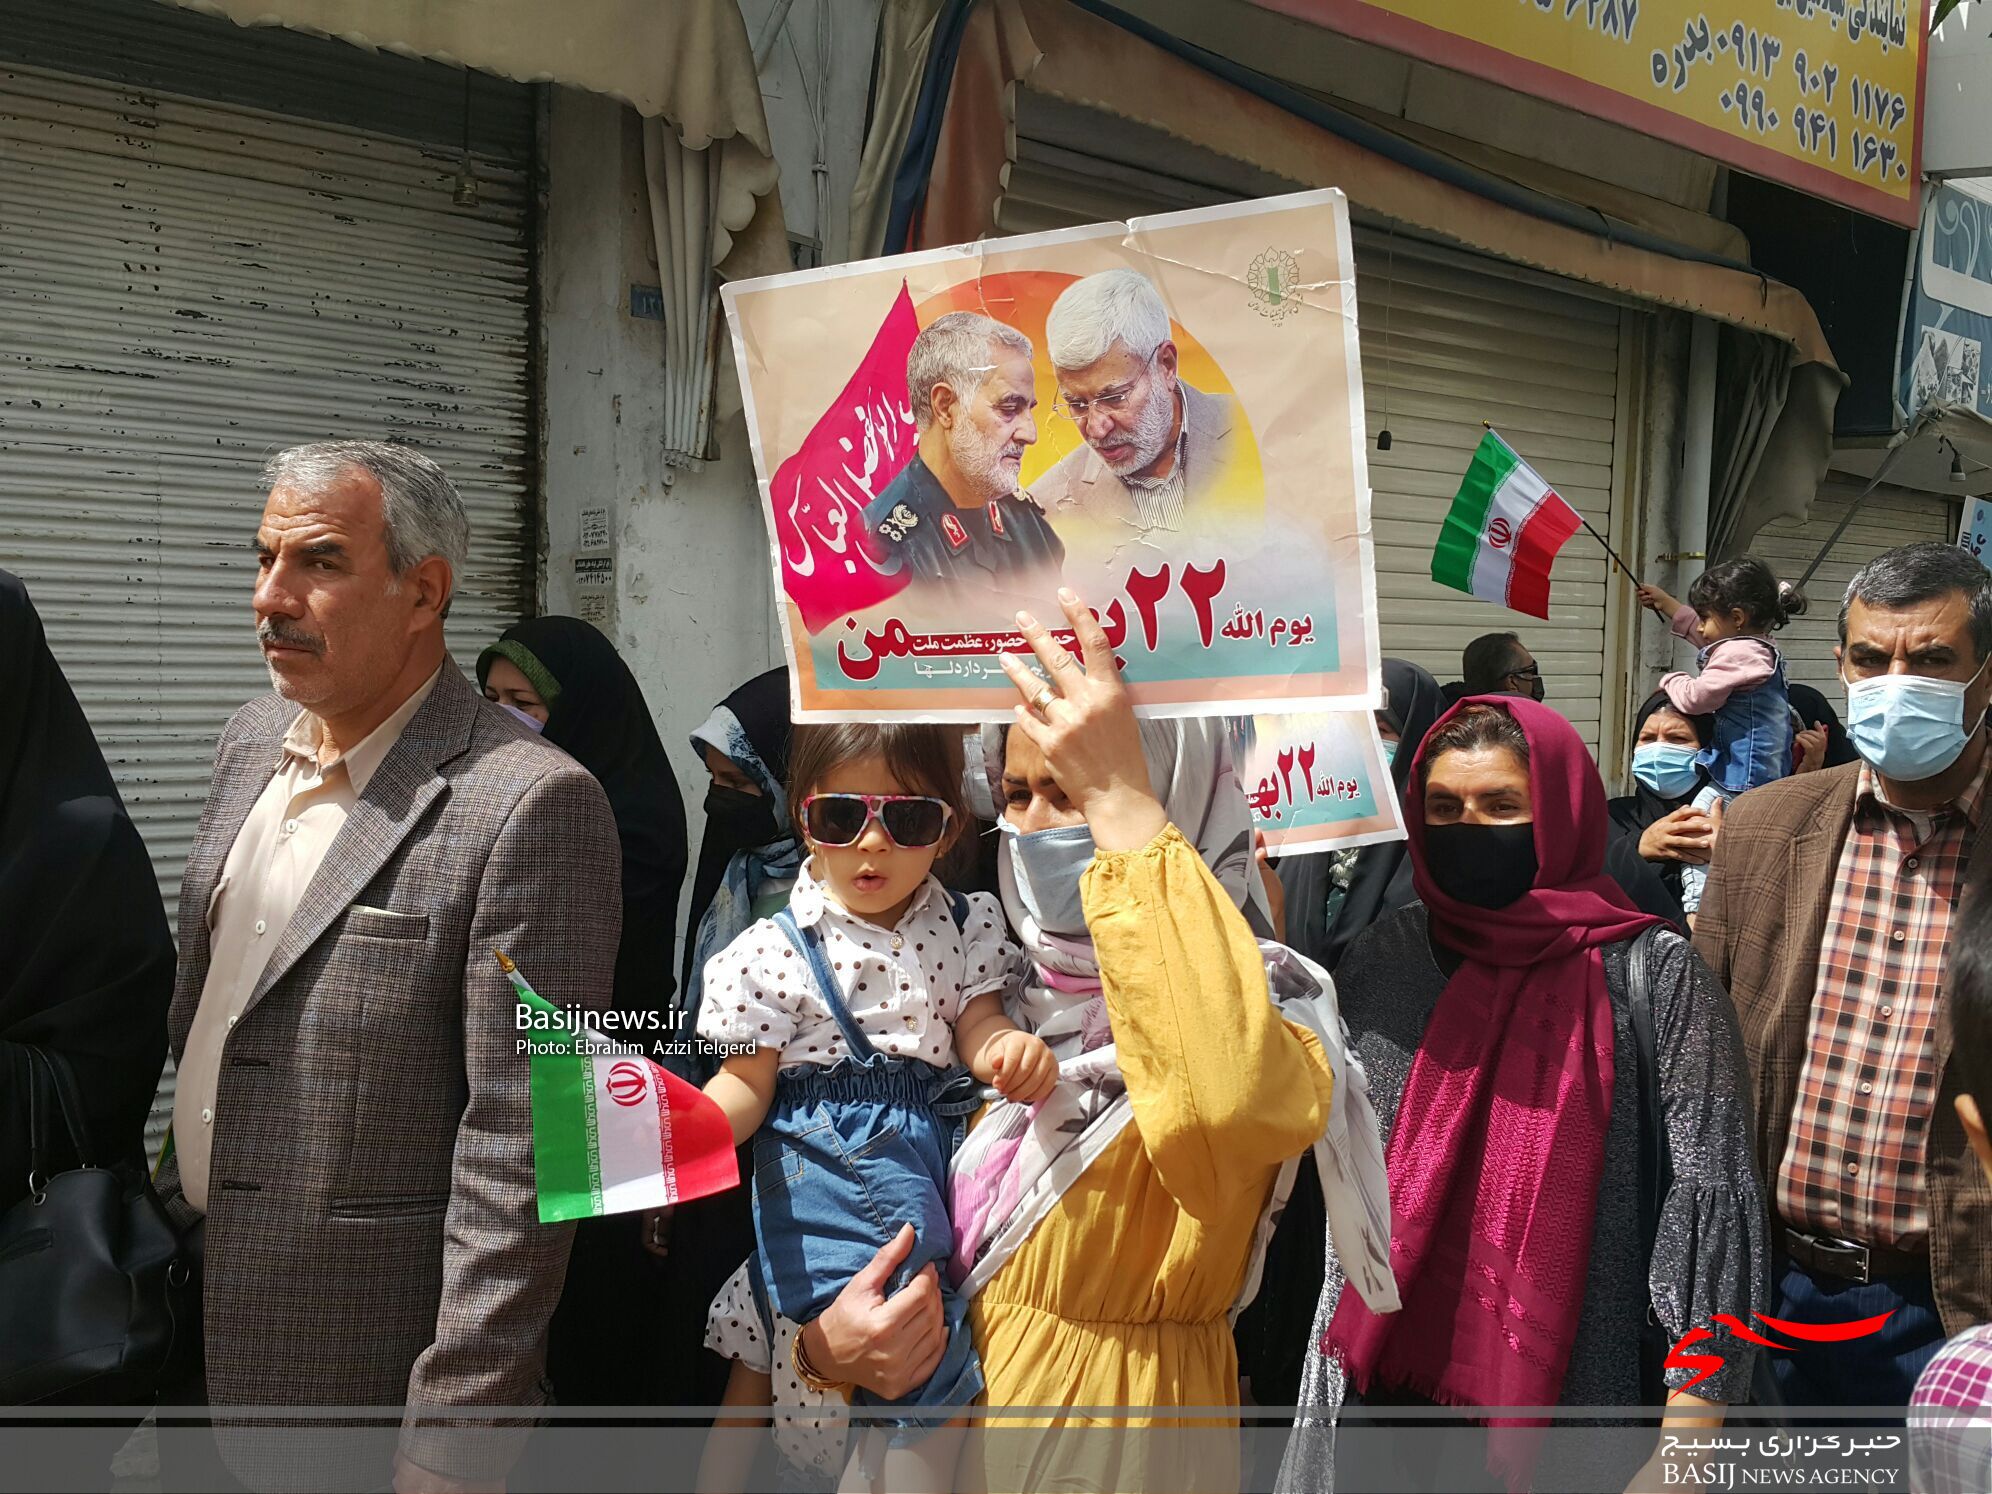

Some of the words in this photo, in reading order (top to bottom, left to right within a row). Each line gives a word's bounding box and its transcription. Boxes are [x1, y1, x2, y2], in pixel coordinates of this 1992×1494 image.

[1715, 22, 1781, 80] ۰۹۱۳
[1793, 50, 1838, 105] ۹۰۲
[1850, 75, 1906, 131] ۱۱۷۶
[1720, 81, 1780, 133] ۰۹۹۰
[1793, 105, 1838, 160] ۹۴۱
[1851, 129, 1907, 181] ۱۶۳۰
[1124, 557, 1226, 652] ۲۲
[1220, 601, 1264, 640] الله
[837, 596, 1128, 682] بمن
[912, 634, 940, 651] ملت
[940, 633, 984, 650] عظمت
[1269, 614, 1315, 647] یوم
[1276, 740, 1316, 806] ۲۲
[1315, 769, 1335, 797] الله
[1336, 776, 1360, 801] یوم
